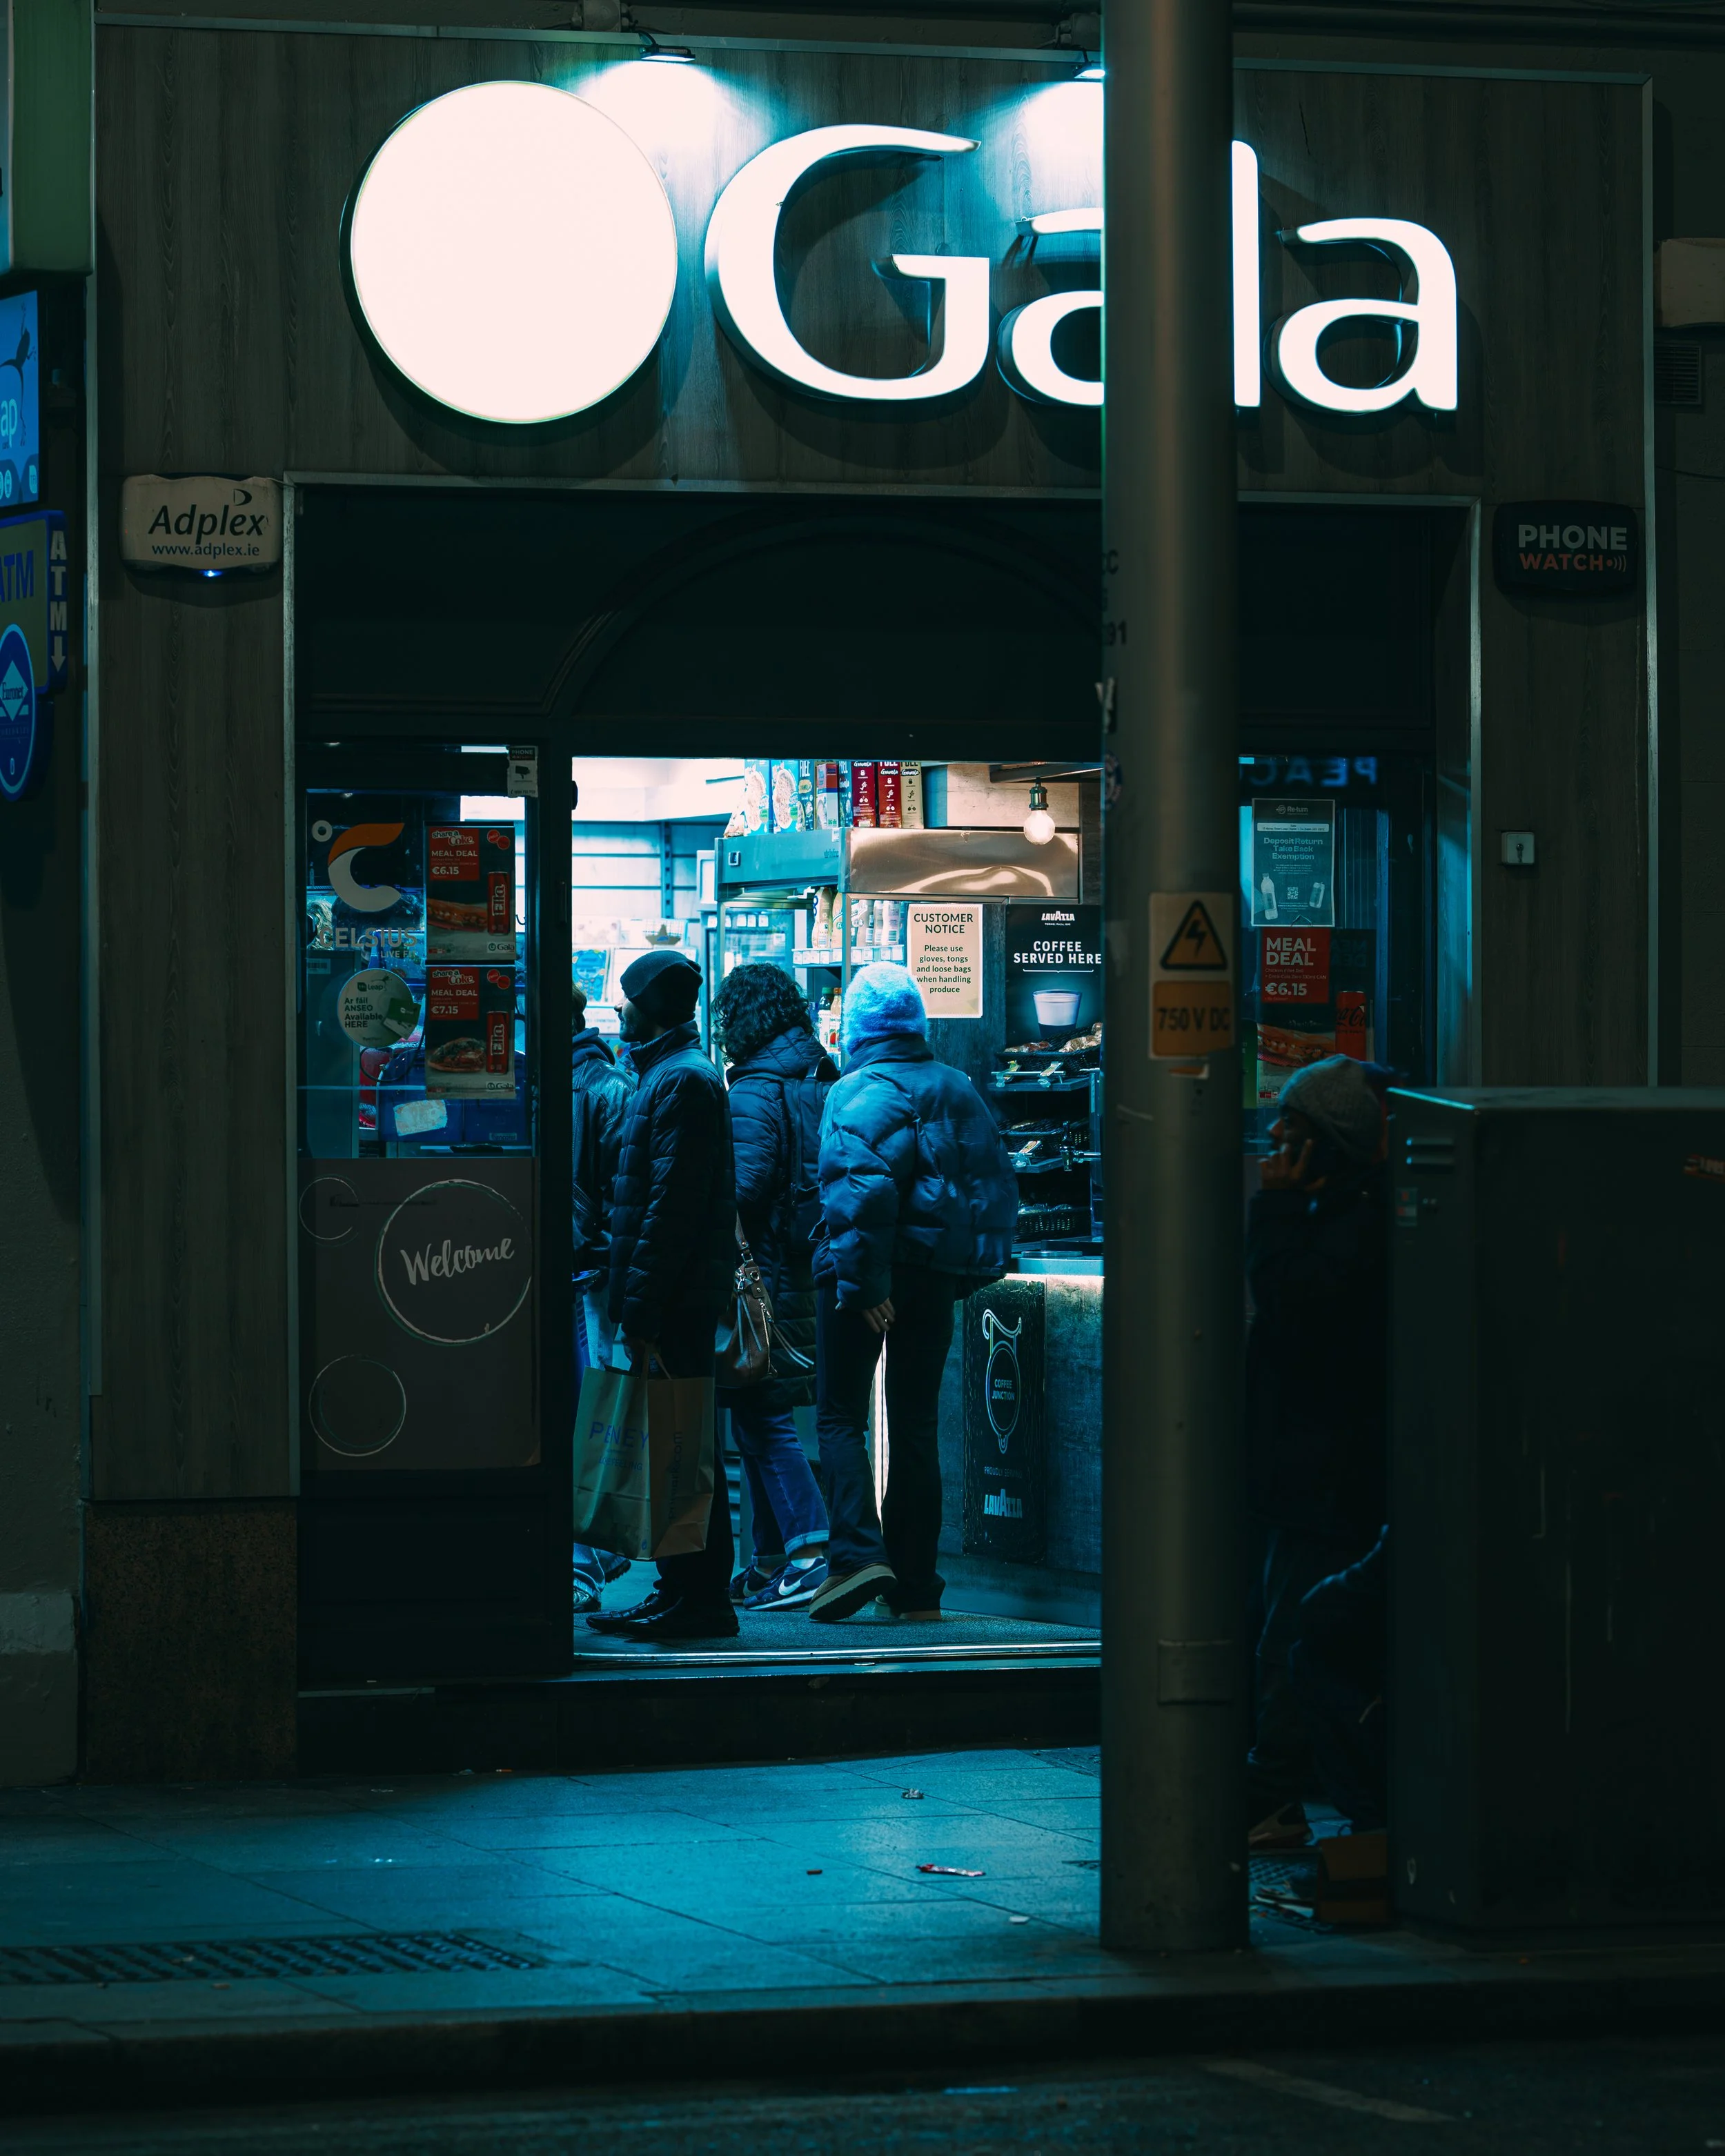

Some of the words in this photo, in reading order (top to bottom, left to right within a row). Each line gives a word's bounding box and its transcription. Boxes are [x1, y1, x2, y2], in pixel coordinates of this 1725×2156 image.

[148, 504, 266, 545] Adplex
[1518, 524, 1628, 551] PHONE
[152, 543, 260, 559] www.adplex.ie
[1519, 553, 1604, 571] WATCH
[50, 530, 68, 632] ATM
[433, 830, 453, 838] share
[448, 835, 475, 847] Coke
[1263, 837, 1294, 845] Deposit
[1272, 853, 1314, 861] Exemption
[431, 866, 460, 875] €6.15
[914, 913, 974, 922] CUSTOMER
[1041, 911, 1075, 921] LAVAZZA
[925, 924, 965, 933] NOTICE
[319, 927, 417, 948] CELSIUS
[1033, 940, 1082, 952] COFFEE
[1265, 937, 1317, 951] MEAL
[380, 950, 400, 958] LIVE
[919, 954, 945, 963] gloves,
[1013, 952, 1064, 964] SERVED
[1068, 953, 1102, 965] HERE
[1265, 951, 1314, 966] DEAL
[954, 965, 972, 973] bags
[448, 974, 475, 986] Coke
[938, 975, 972, 985] handling
[929, 986, 960, 994] produce
[1264, 982, 1308, 996] €6.15
[431, 1006, 459, 1014] €7.15
[344, 1012, 384, 1020] Available
[1156, 1007, 1190, 1031] 750
[1192, 1007, 1205, 1031] V
[1210, 1007, 1231, 1031] DC
[400, 1238, 515, 1285] Welcome
[994, 1378, 1013, 1389] COFFEE
[992, 1390, 1015, 1400] JUNCTION
[983, 1488, 1023, 1519] LAVAZZA
